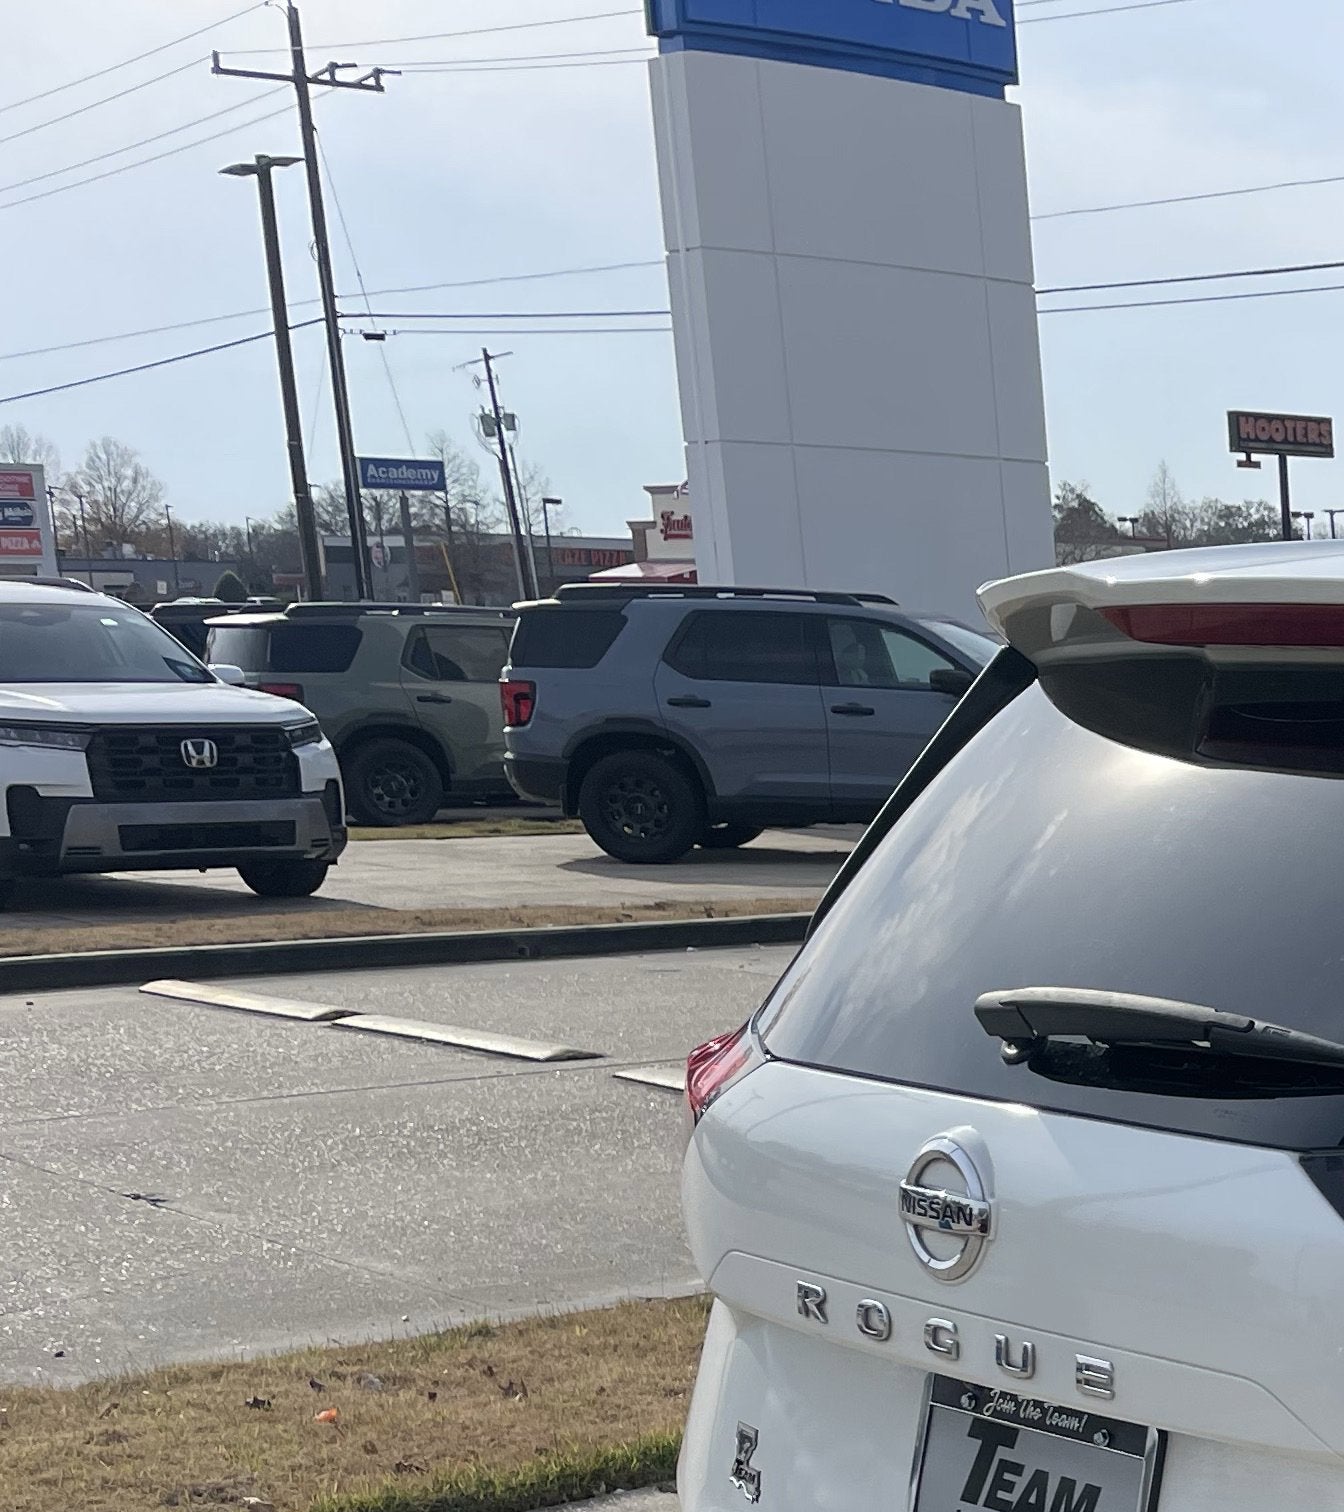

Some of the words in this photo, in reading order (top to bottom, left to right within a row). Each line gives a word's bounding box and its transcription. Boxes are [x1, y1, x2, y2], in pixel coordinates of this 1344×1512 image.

[1237, 416, 1332, 445] HOOTERS
[367, 463, 440, 484] Academy
[900, 1186, 974, 1227] NISSAN
[796, 1280, 1115, 1401] ROGUE
